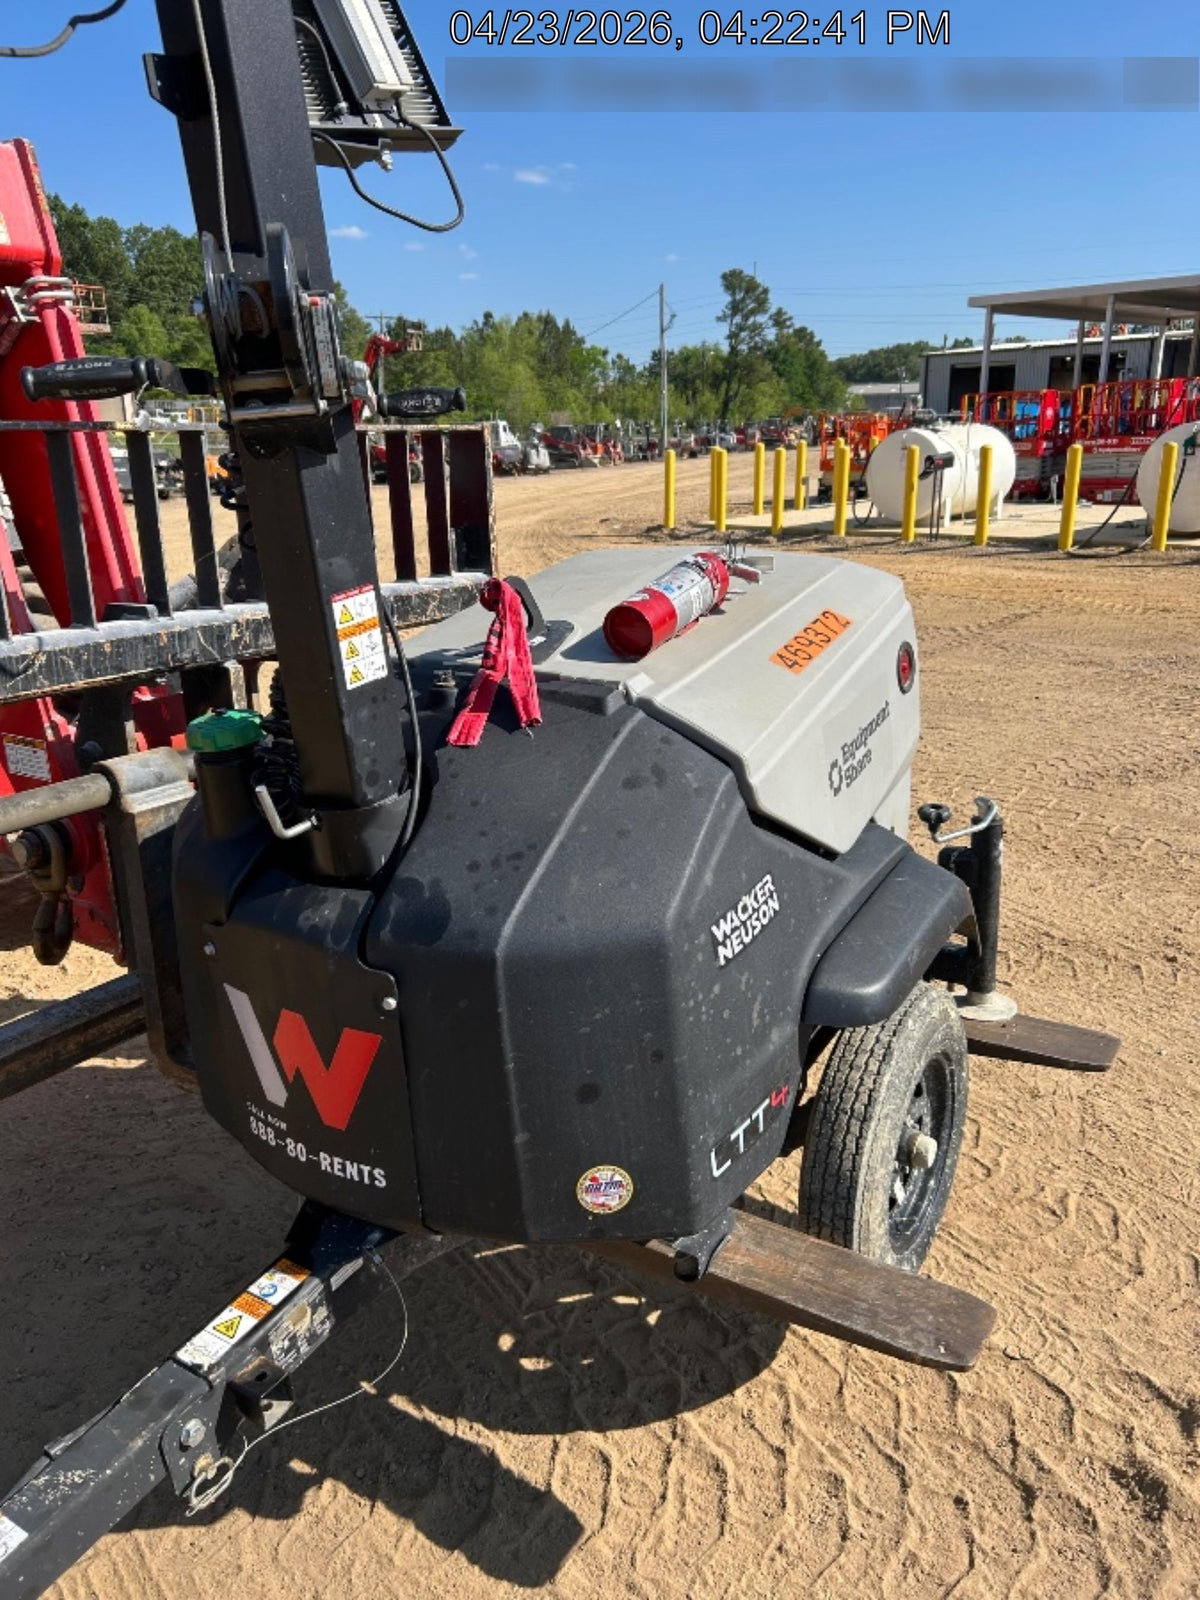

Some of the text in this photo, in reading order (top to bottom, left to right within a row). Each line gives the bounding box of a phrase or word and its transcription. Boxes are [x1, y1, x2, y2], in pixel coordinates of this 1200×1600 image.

[776, 609, 852, 669] 469372
[841, 700, 890, 764] Equipment
[844, 748, 872, 789] Share
[711, 873, 776, 942] WACKER
[717, 891, 780, 966] NEUSON
[249, 1116, 387, 1189] 888-80-RENTS
[267, 1113, 288, 1132] NOW
